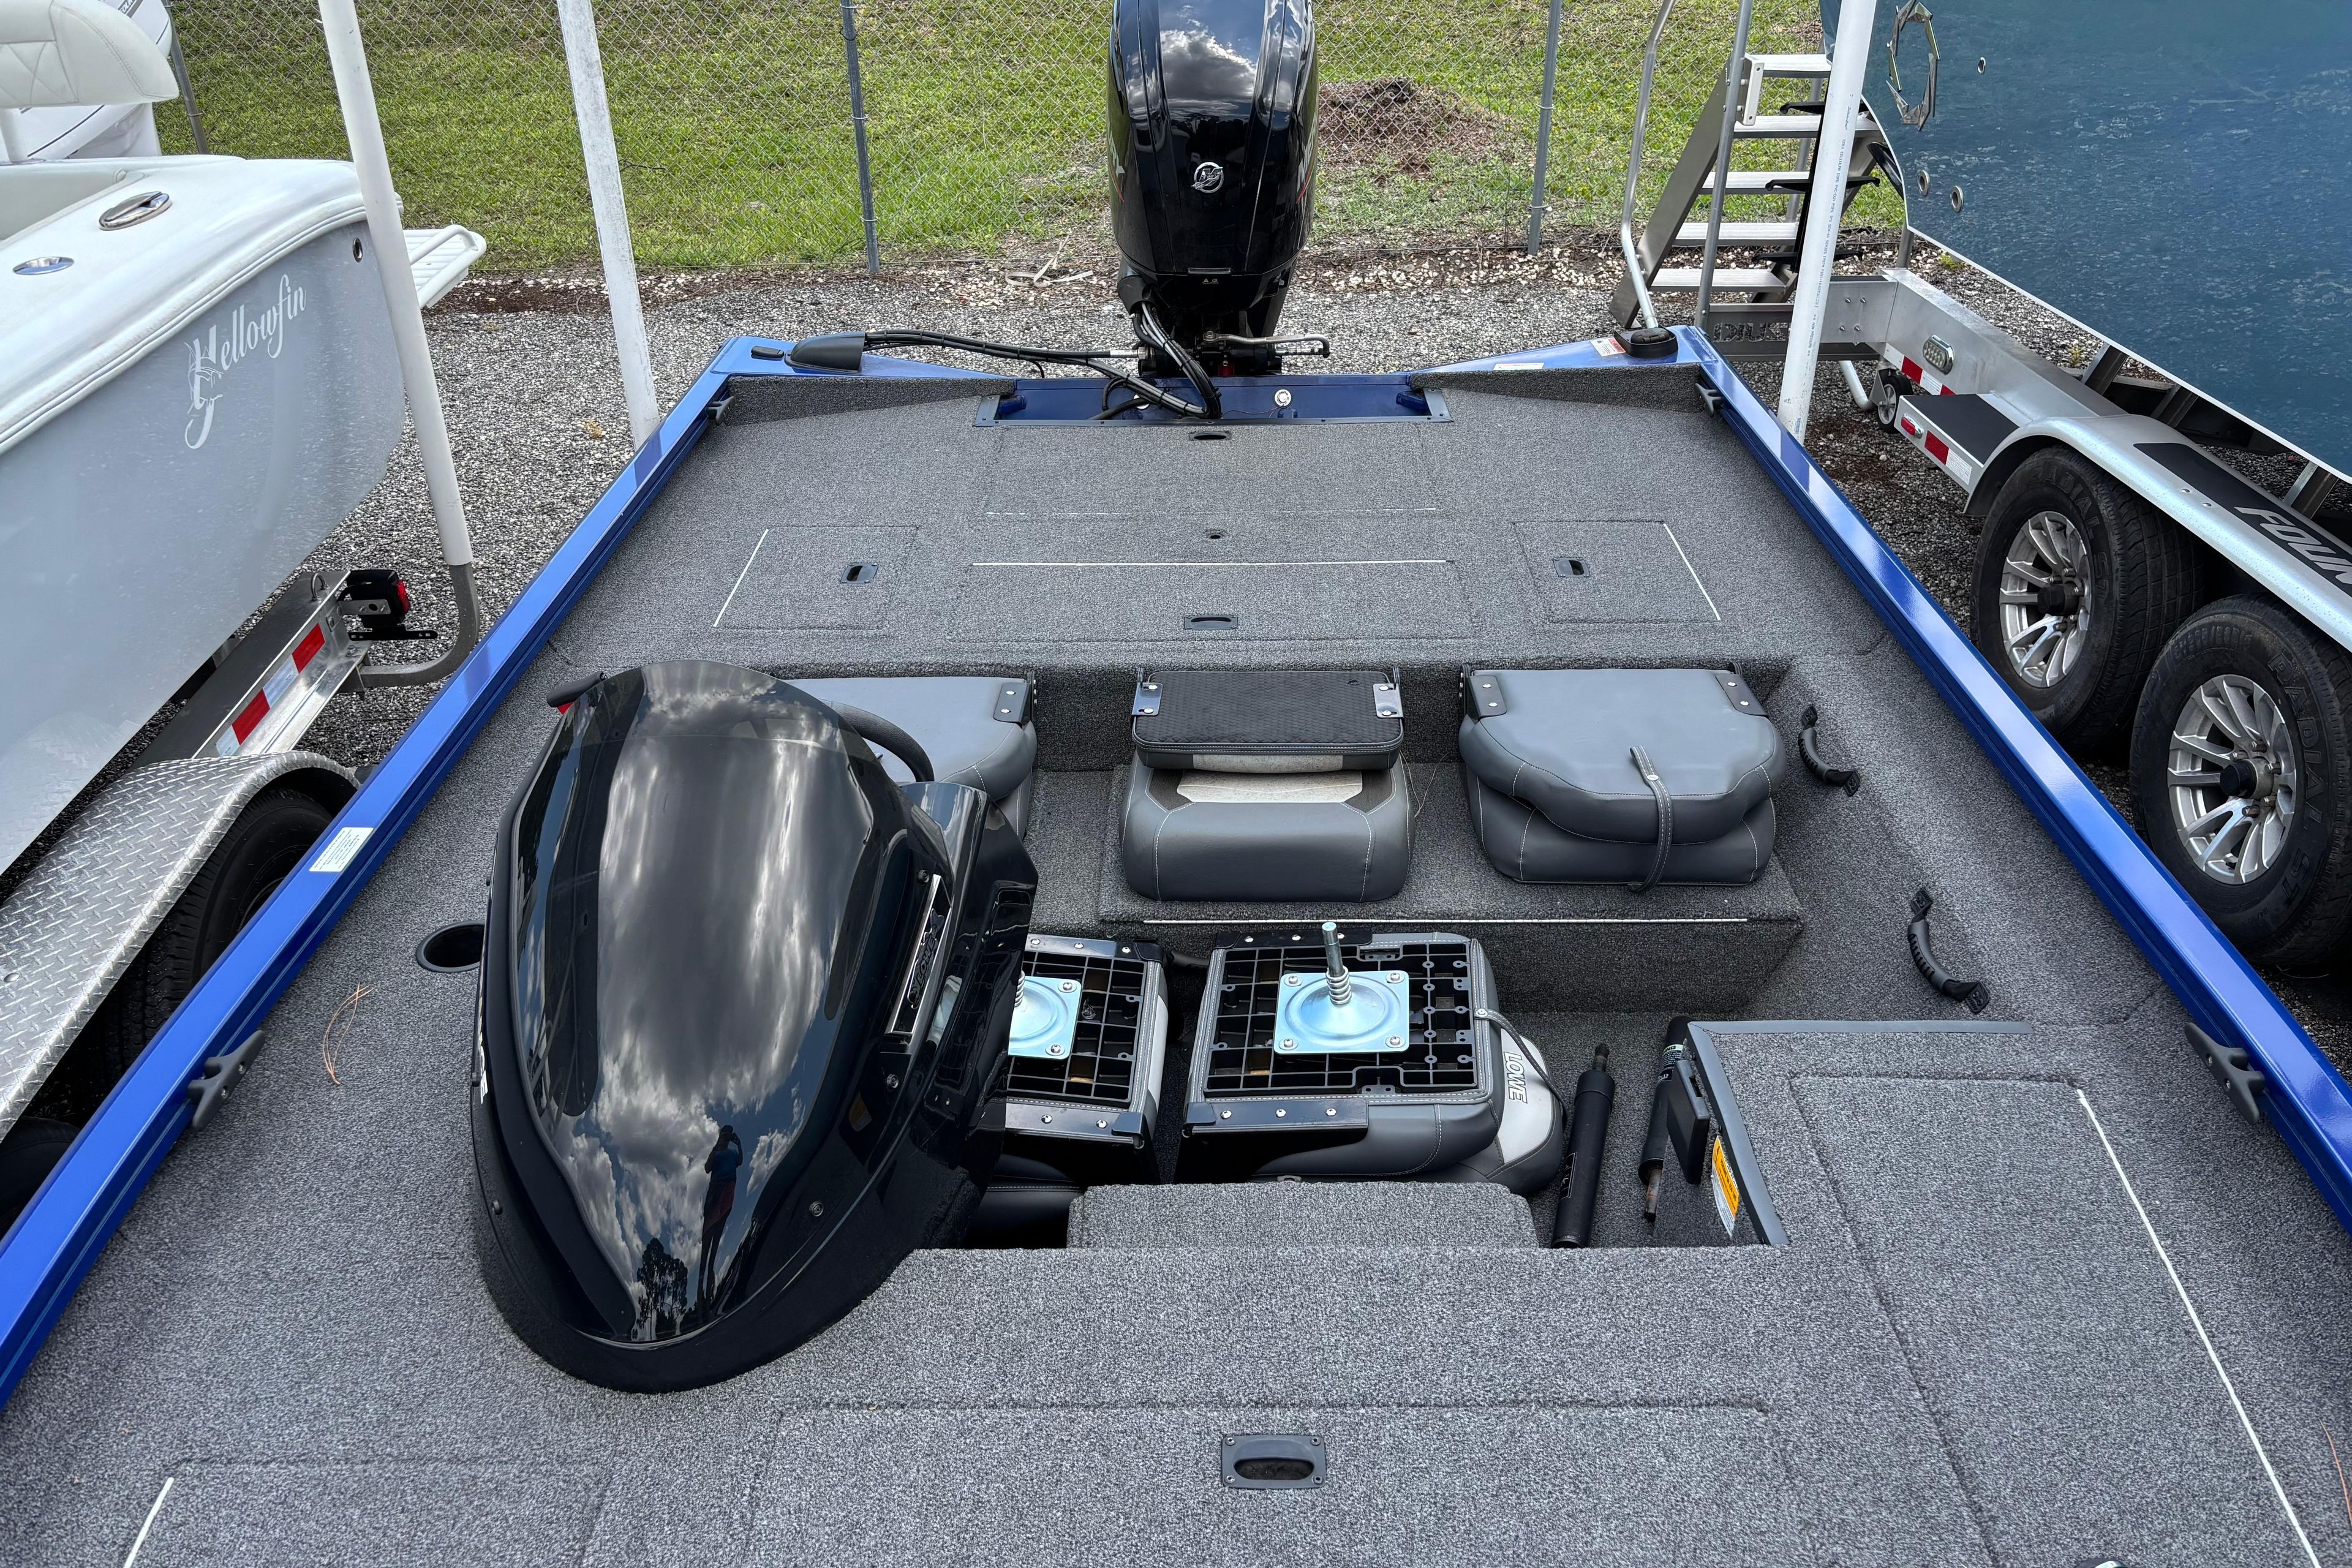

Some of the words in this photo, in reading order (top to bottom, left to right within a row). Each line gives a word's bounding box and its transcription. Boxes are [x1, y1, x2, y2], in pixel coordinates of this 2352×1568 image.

[184, 274, 306, 449] Yellowfin
[2267, 652, 2324, 831] RADIAL
[915, 935, 936, 987] LOWE
[1503, 1051, 1528, 1104] LOWE
